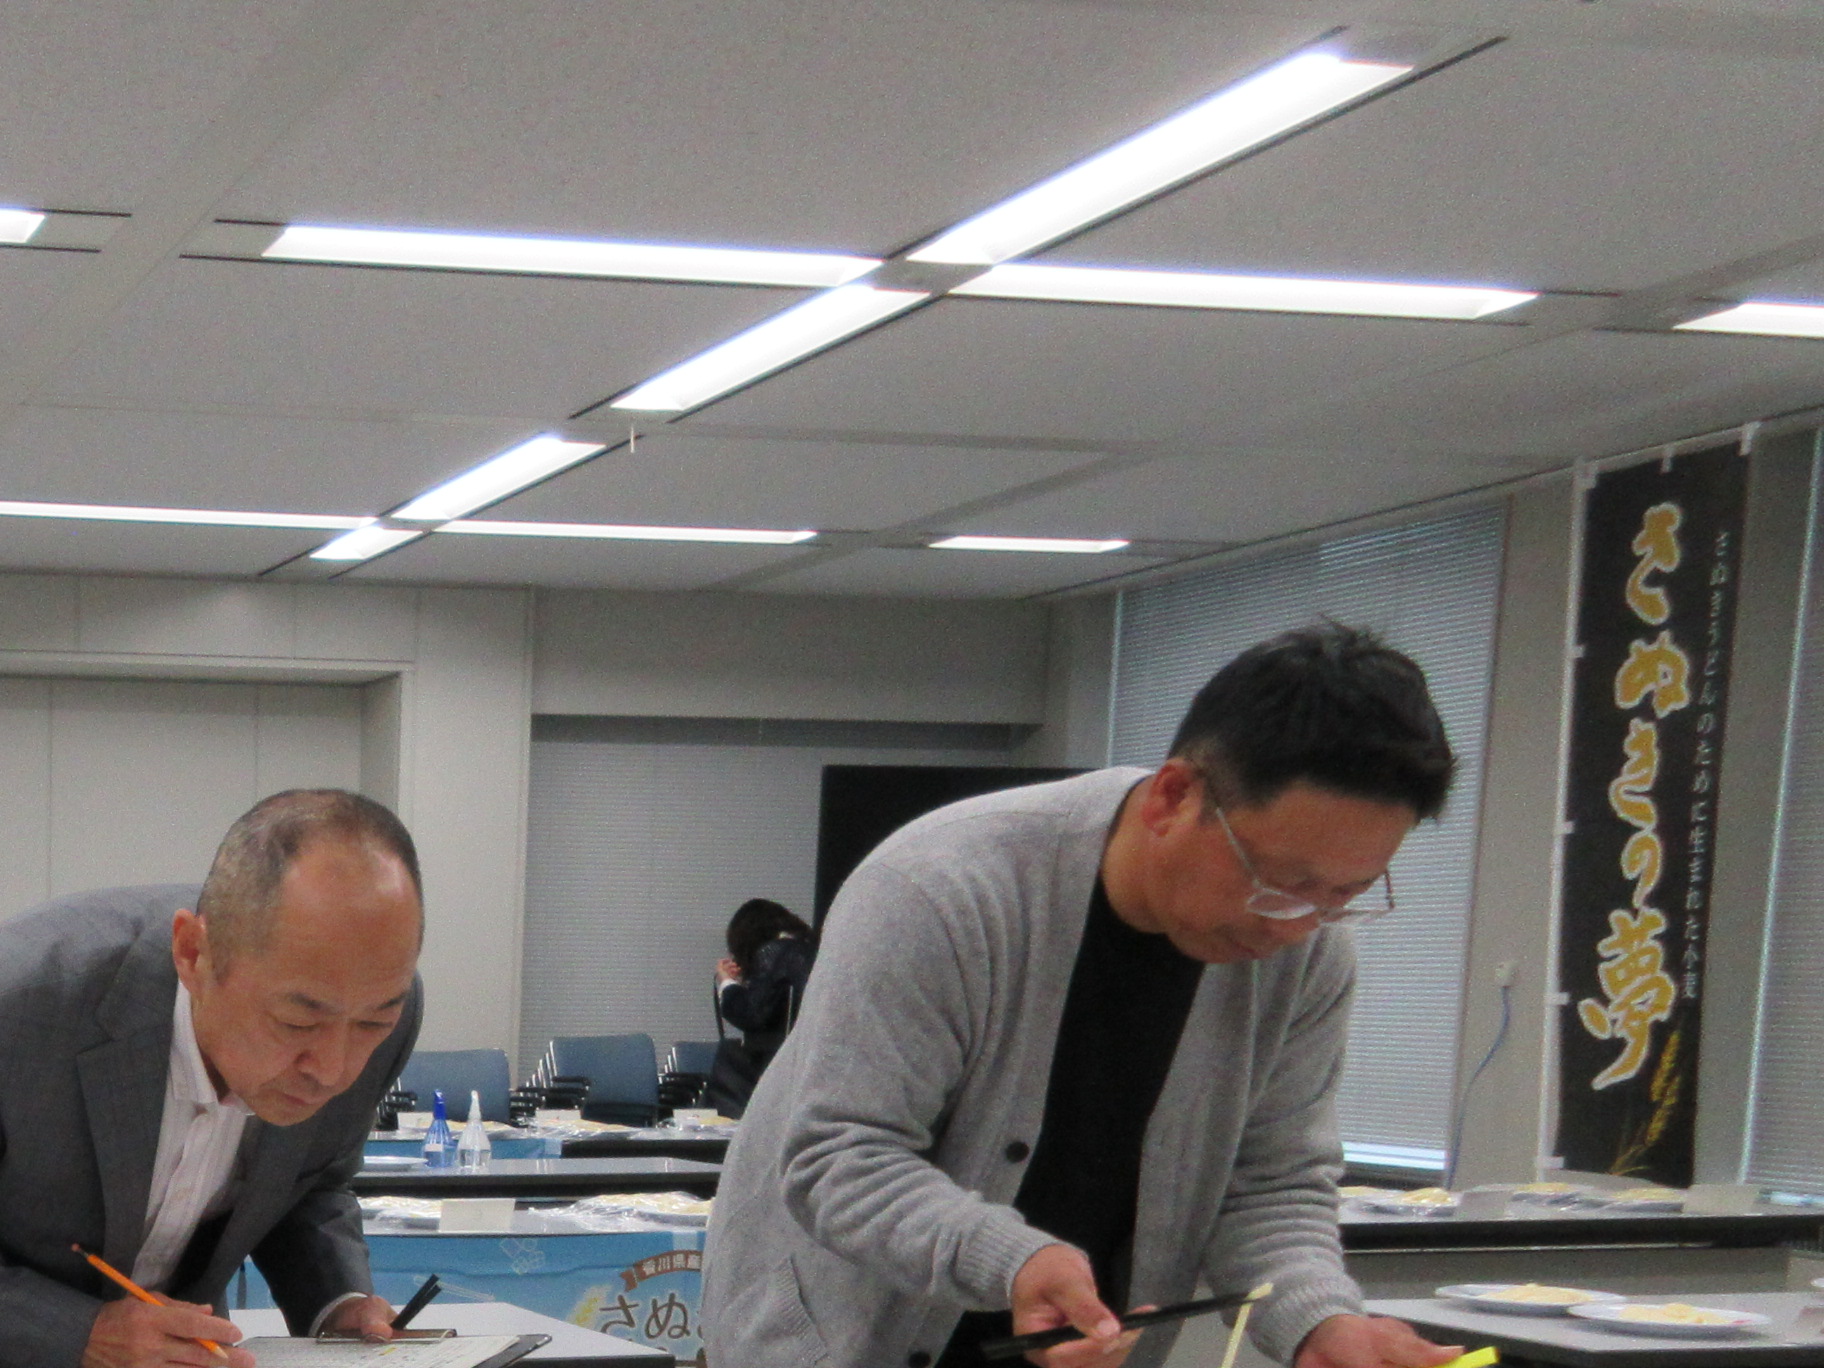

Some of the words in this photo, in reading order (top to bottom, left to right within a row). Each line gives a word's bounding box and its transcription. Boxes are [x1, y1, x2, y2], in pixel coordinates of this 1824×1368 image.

[1577, 501, 1692, 1091] さぬきの夢
[599, 1292, 704, 1340] さぬ
